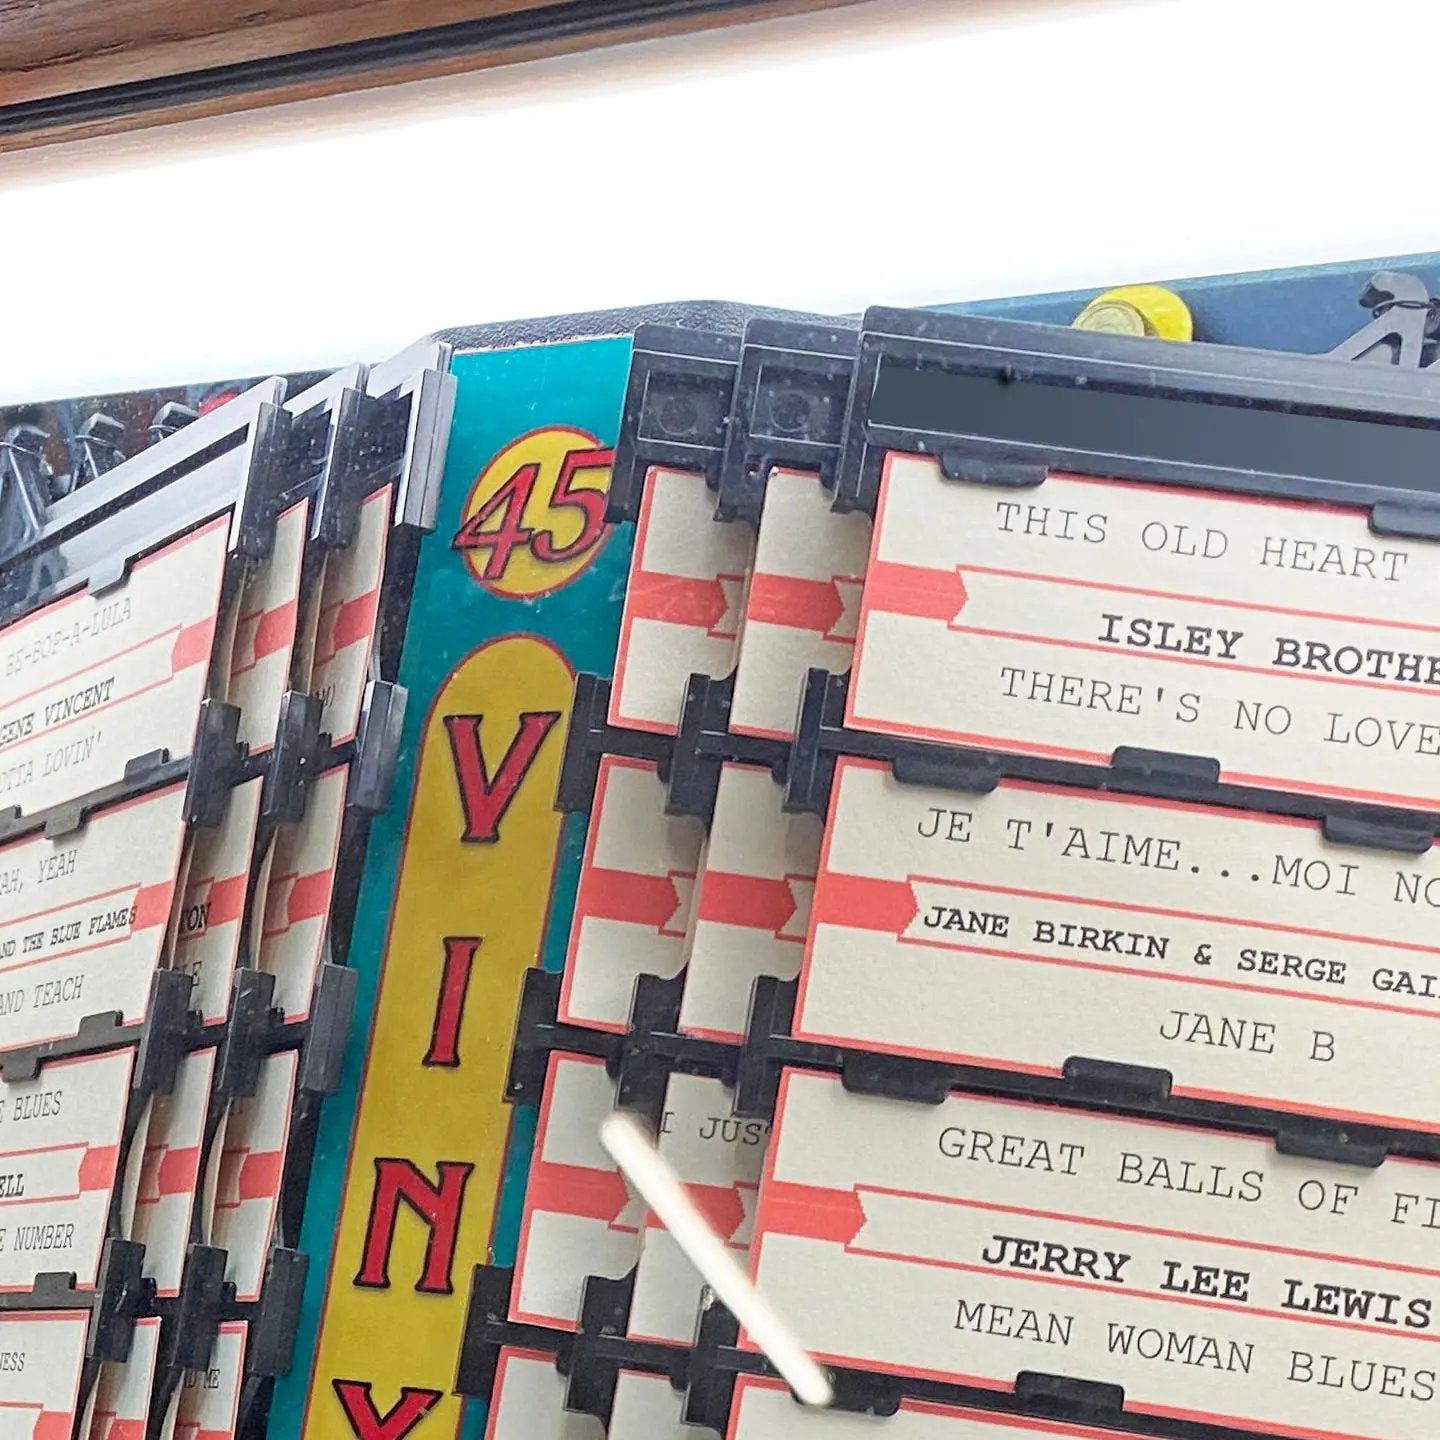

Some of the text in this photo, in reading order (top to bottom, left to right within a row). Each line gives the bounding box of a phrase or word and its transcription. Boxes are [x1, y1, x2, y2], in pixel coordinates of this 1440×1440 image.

[449, 448, 617, 580] 45
[996, 501, 1409, 582] THIS OLD HEART
[1098, 613, 1244, 660] ISLEY
[44, 676, 116, 727] VINCENT
[1000, 666, 1440, 756] THERE'S NO LOVE
[37, 849, 78, 884] YEAH
[917, 808, 1359, 896] JE T'AIME...MOI
[923, 906, 1009, 938] JANE
[1032, 919, 1170, 960] BIRKIN
[1193, 943, 1212, 966] &
[1236, 948, 1347, 985] SERGE
[32, 973, 85, 1009] TEACH
[1159, 1010, 1335, 1062] JANE B
[12, 1089, 63, 1122] BLUES
[938, 1126, 1085, 1176] GREAT
[1117, 1152, 1264, 1202] BALLS
[1298, 1179, 1359, 1215] OF
[13, 1223, 75, 1251] NUMBER
[981, 1234, 1432, 1329] JERRY LEE LEWIS
[954, 1299, 1436, 1402] MEAN WOMAN BLUES
